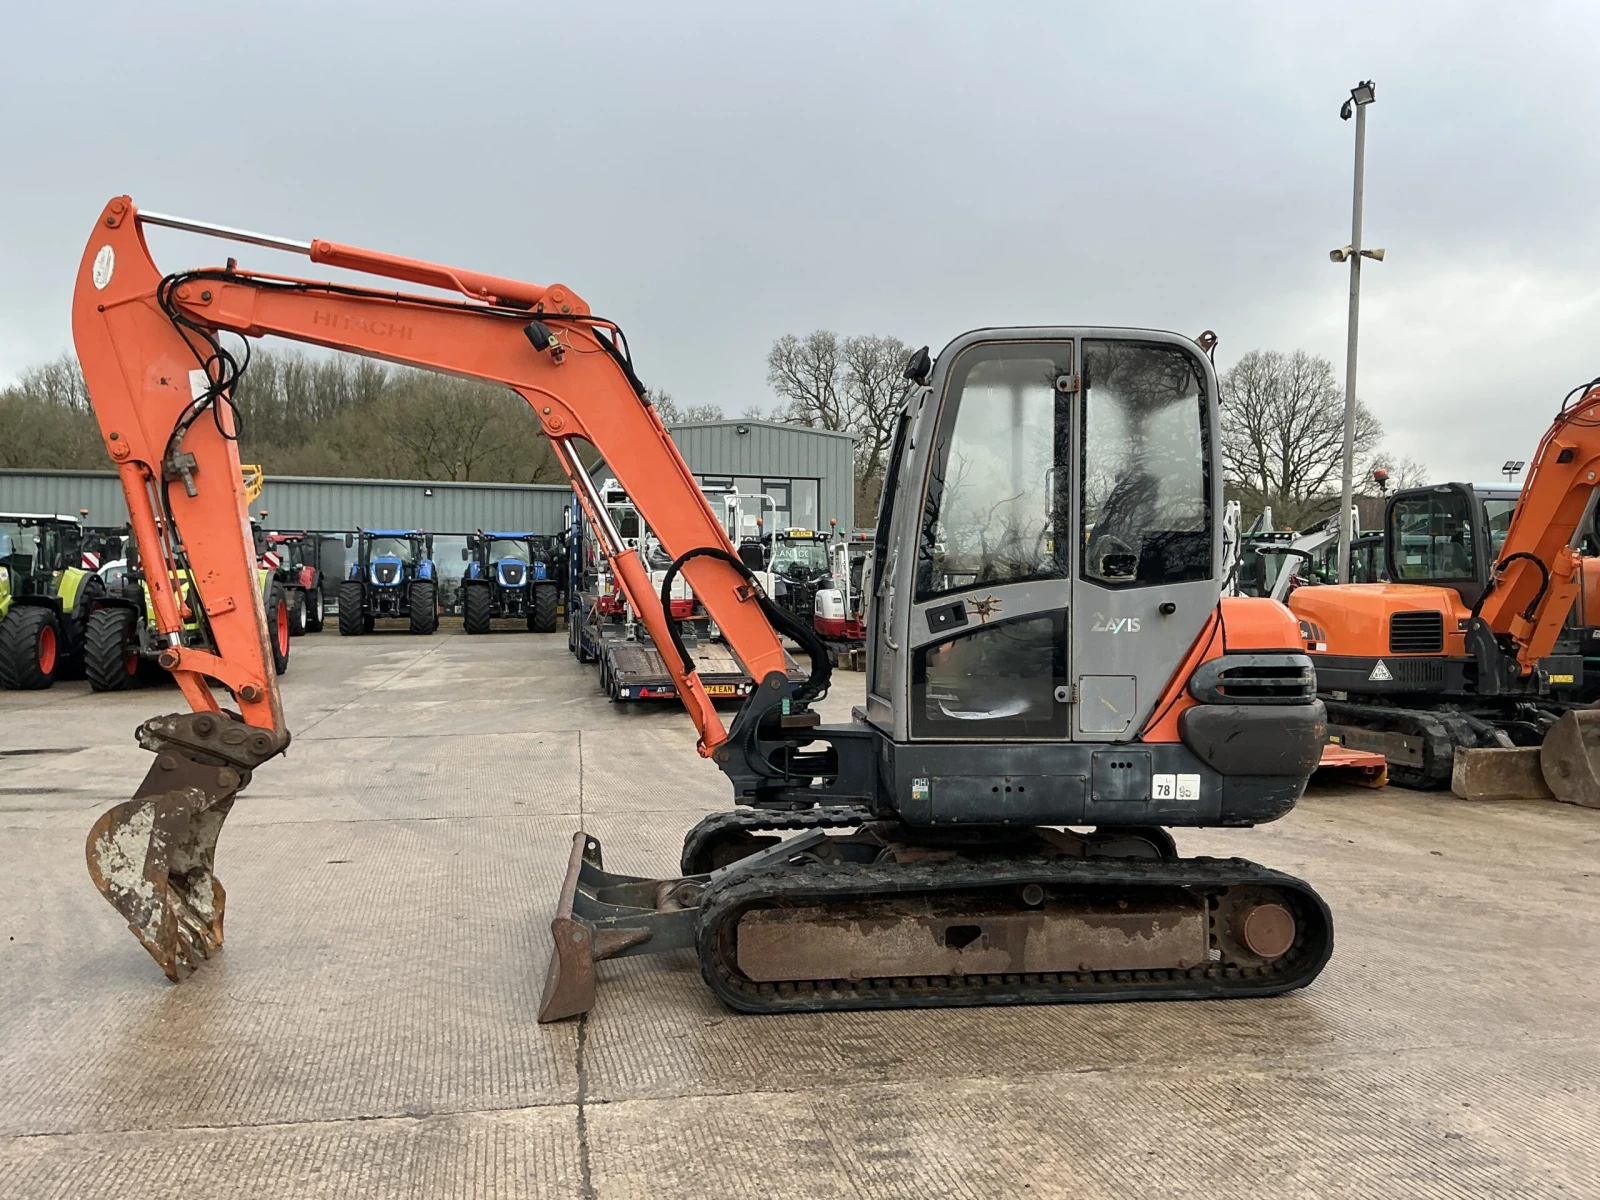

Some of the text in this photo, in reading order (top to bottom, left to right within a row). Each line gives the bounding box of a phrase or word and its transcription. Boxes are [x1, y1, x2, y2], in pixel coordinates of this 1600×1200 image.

[313, 310, 414, 340] HITACHI
[718, 685, 733, 693] EAN
[1157, 784, 1171, 797] 78
